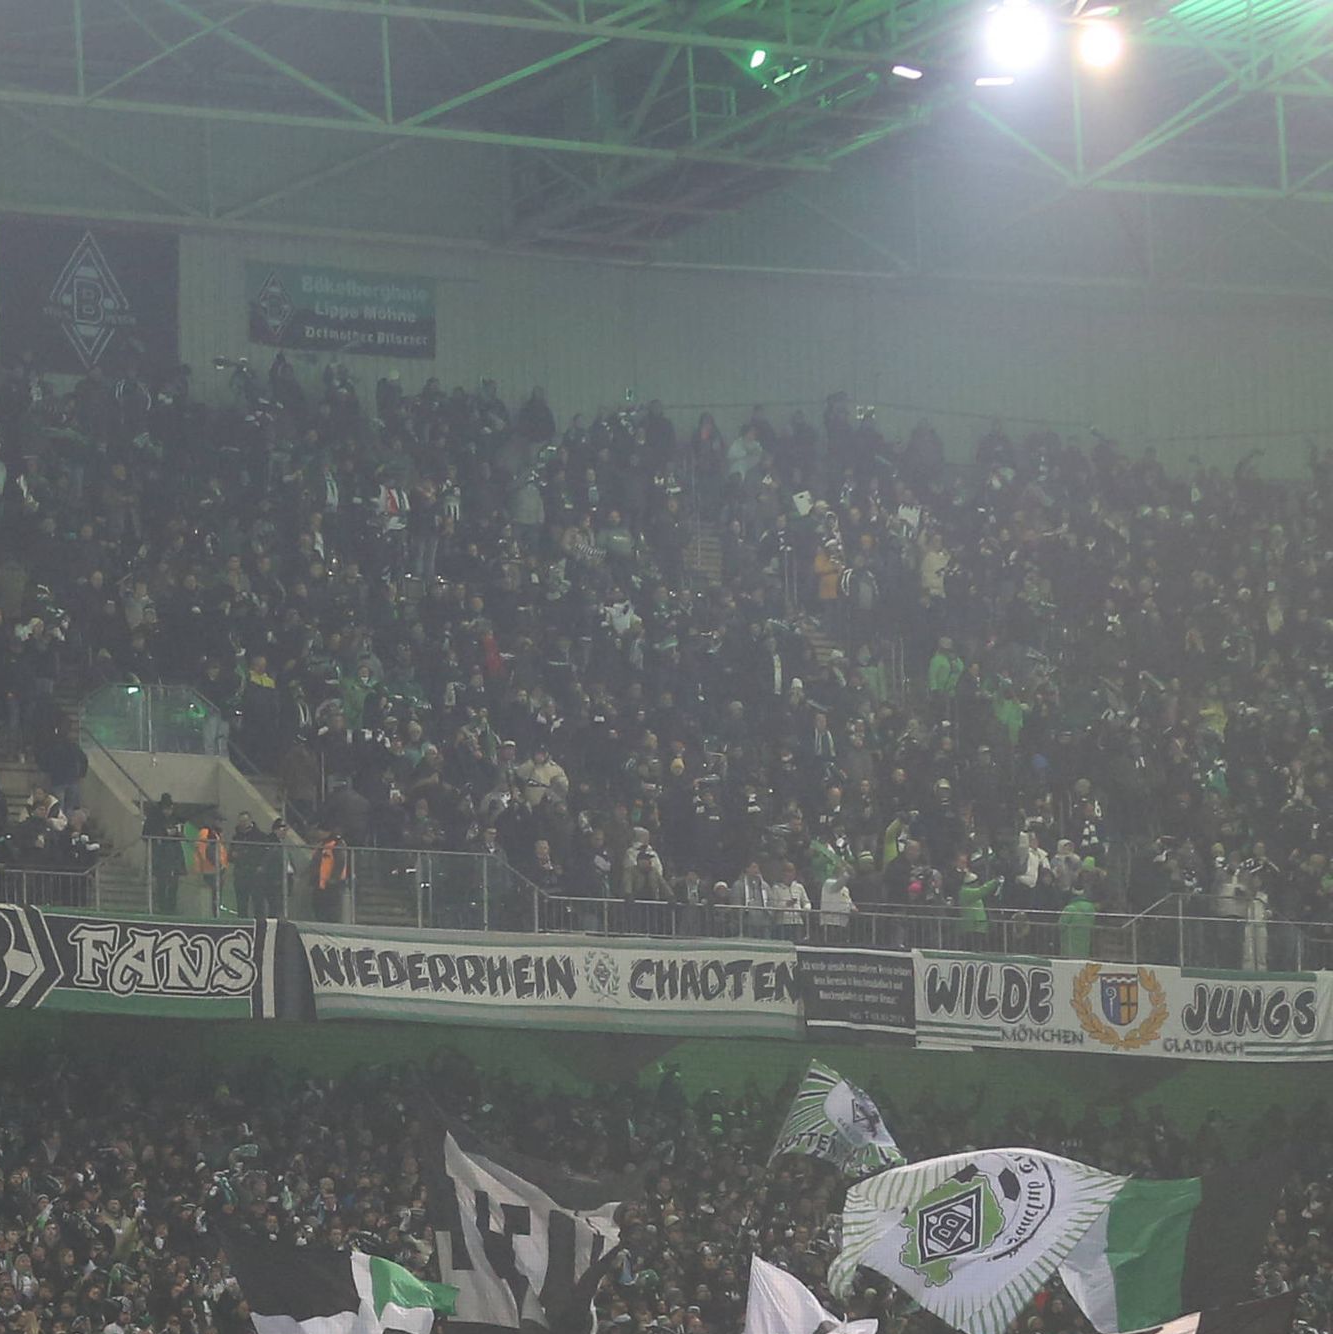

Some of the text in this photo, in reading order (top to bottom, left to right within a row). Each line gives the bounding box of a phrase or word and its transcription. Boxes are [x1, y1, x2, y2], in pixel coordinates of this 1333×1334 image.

[68, 921, 258, 997] FANS
[309, 943, 802, 1004] NIEDERRHEIN CHAOTEN
[923, 961, 1317, 1039] WILDE JUNGS
[999, 1025, 1085, 1046] MÖNCHEN
[1162, 1037, 1246, 1056] GLADBACH
